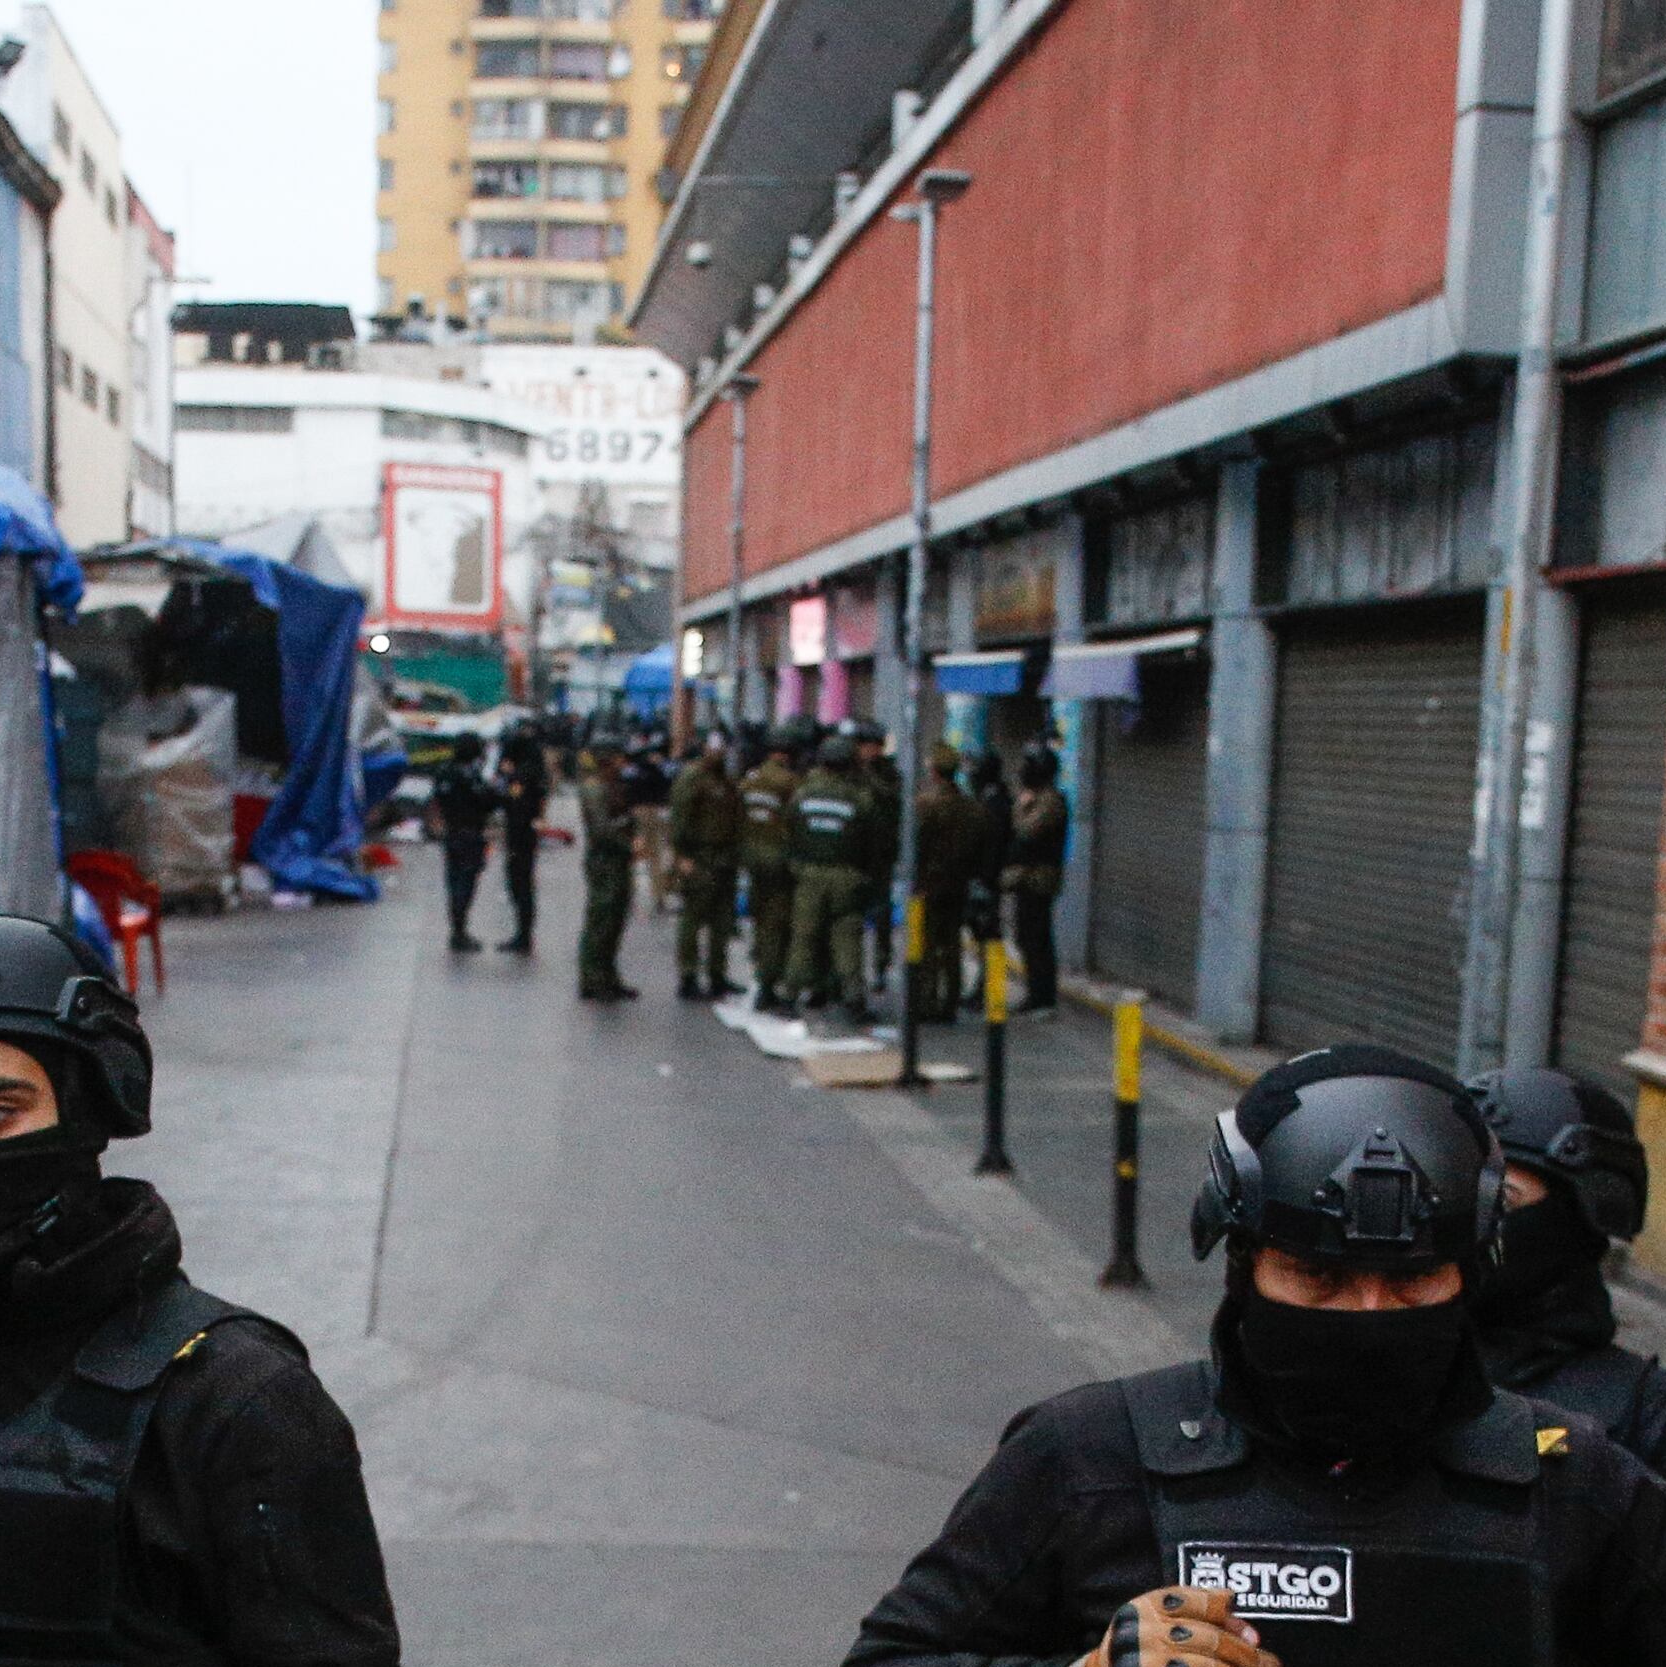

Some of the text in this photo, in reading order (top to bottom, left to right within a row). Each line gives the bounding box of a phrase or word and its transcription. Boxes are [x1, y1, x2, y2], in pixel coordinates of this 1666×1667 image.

[544, 426, 663, 464] 6897
[1227, 1561, 1341, 1597] STGO
[1236, 1592, 1329, 1610] SEGURIDAD
